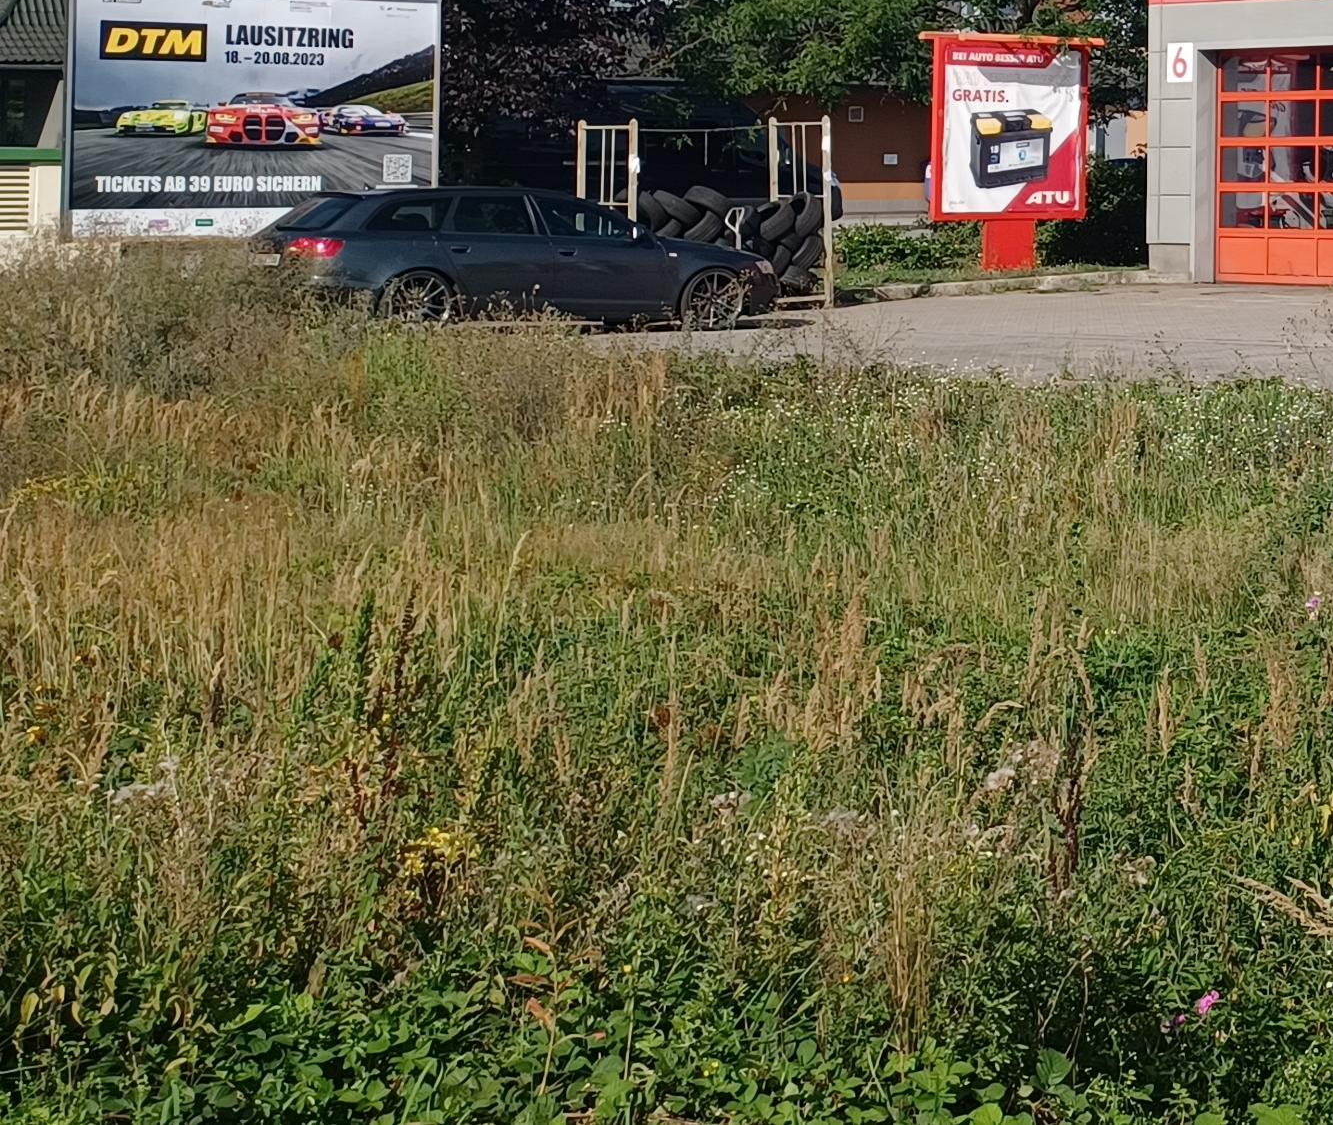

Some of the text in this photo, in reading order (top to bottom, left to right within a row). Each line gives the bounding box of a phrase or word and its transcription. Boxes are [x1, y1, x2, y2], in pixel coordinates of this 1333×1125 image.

[105, 27, 203, 56] DTM
[225, 24, 354, 49] LAUSITZRING
[953, 52, 967, 60] BEI
[968, 52, 993, 61] AUTO
[1026, 55, 1044, 63] ATU
[1172, 46, 1188, 78] 6
[952, 88, 1009, 103] GRATIS.
[95, 176, 322, 193] TICKETS AB 39 EURO SICHERN
[1025, 190, 1070, 205] ATU
